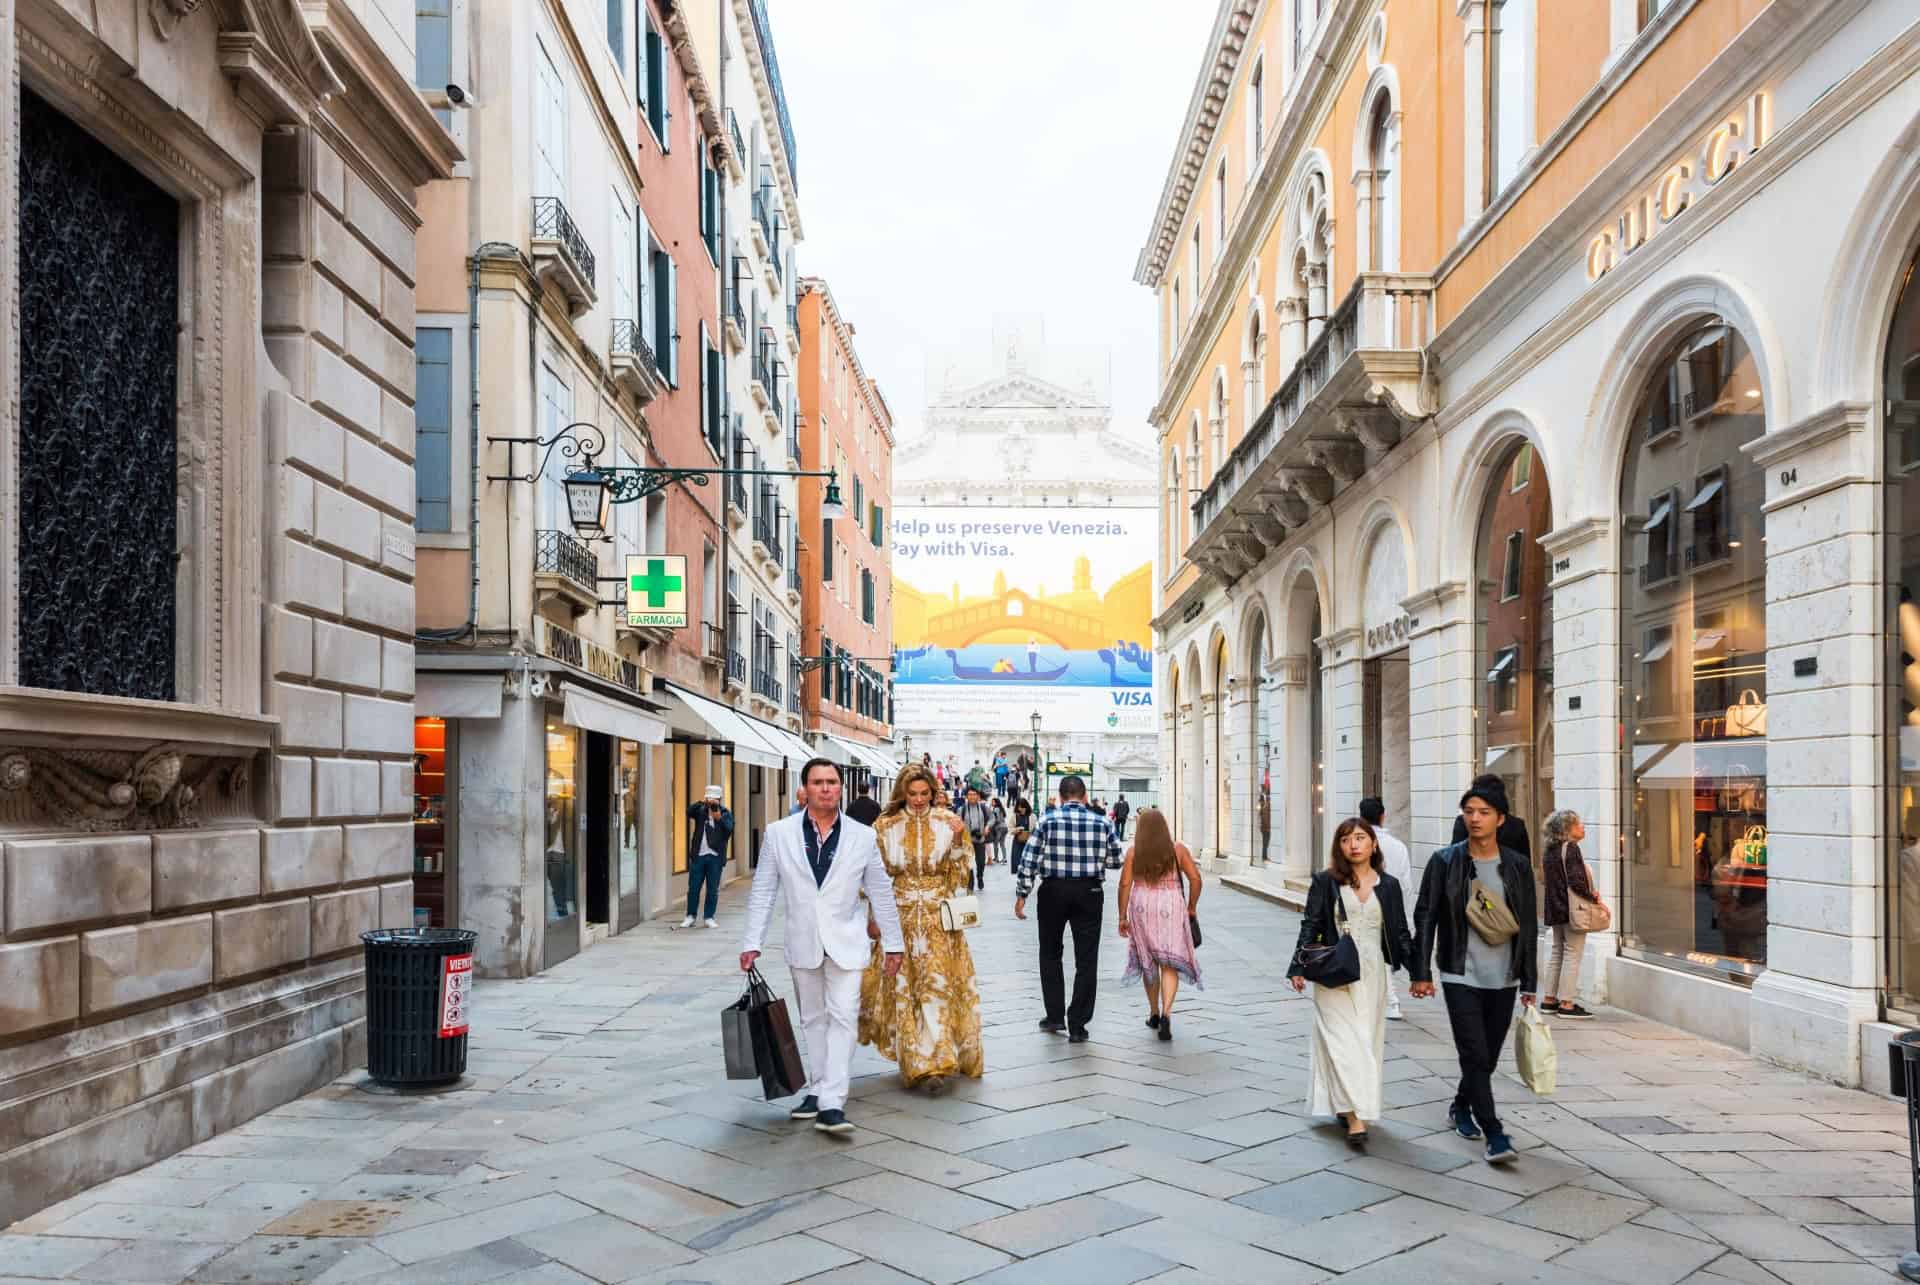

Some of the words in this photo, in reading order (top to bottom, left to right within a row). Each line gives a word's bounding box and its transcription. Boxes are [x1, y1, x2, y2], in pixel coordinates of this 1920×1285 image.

[1586, 92, 1768, 283] GUCCI
[935, 523, 955, 534] us
[961, 522, 1043, 537] preserve
[1048, 521, 1128, 536] Venezia.
[925, 541, 965, 556] with
[970, 542, 1015, 557] Visa.
[630, 615, 683, 625] FARMACIA
[1111, 691, 1153, 706] VISA
